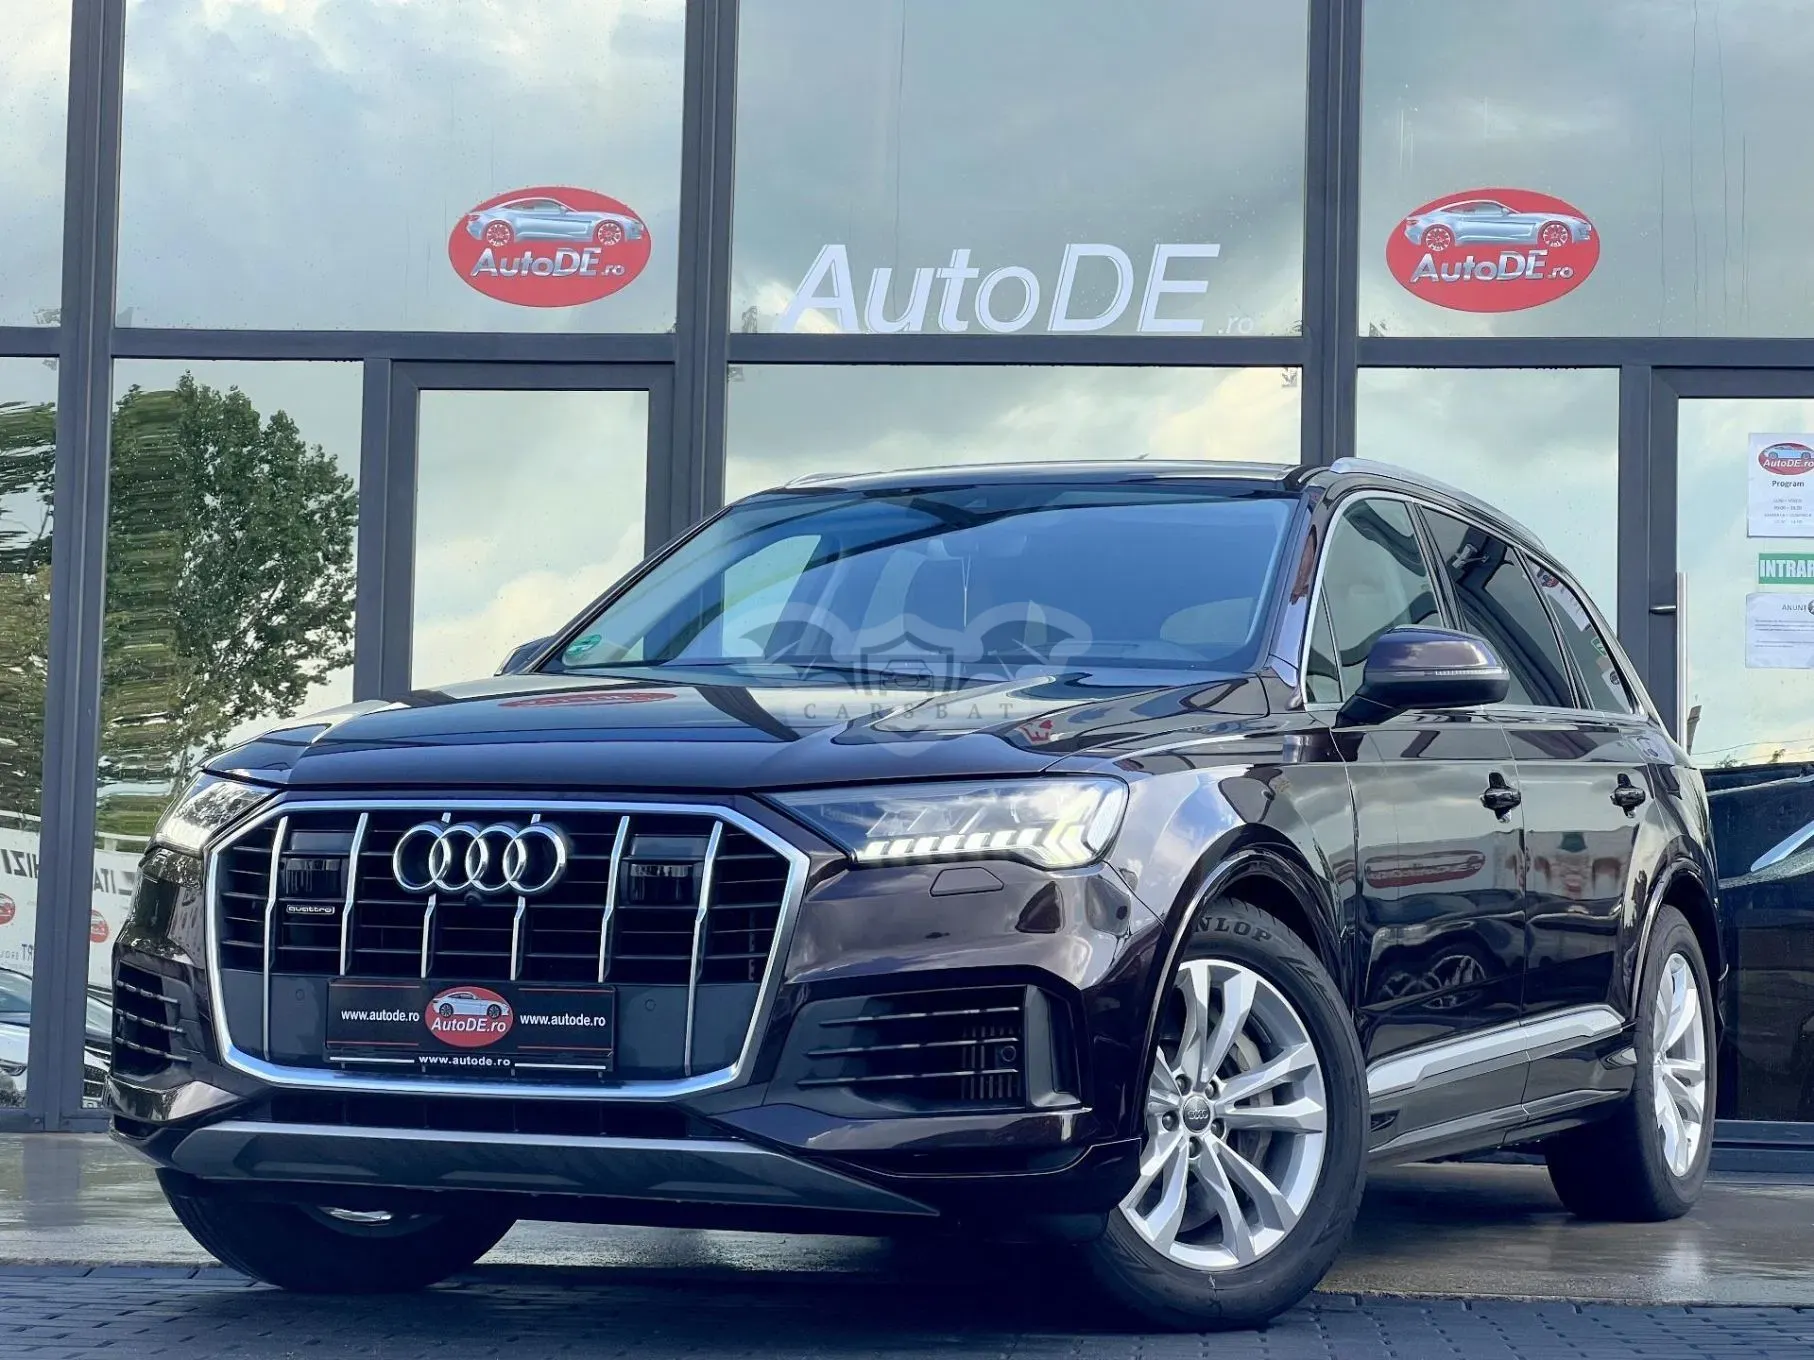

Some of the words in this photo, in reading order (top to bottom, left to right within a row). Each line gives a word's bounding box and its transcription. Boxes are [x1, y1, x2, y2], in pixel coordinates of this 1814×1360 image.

[1771, 480, 1805, 488] Program
[288, 905, 332, 913] quattro
[341, 1009, 420, 1022] www.autode.ro
[520, 1013, 606, 1027] www.autode.ro
[431, 1017, 506, 1033] AutoDE.ro
[418, 1055, 511, 1067] www.autode.ro
